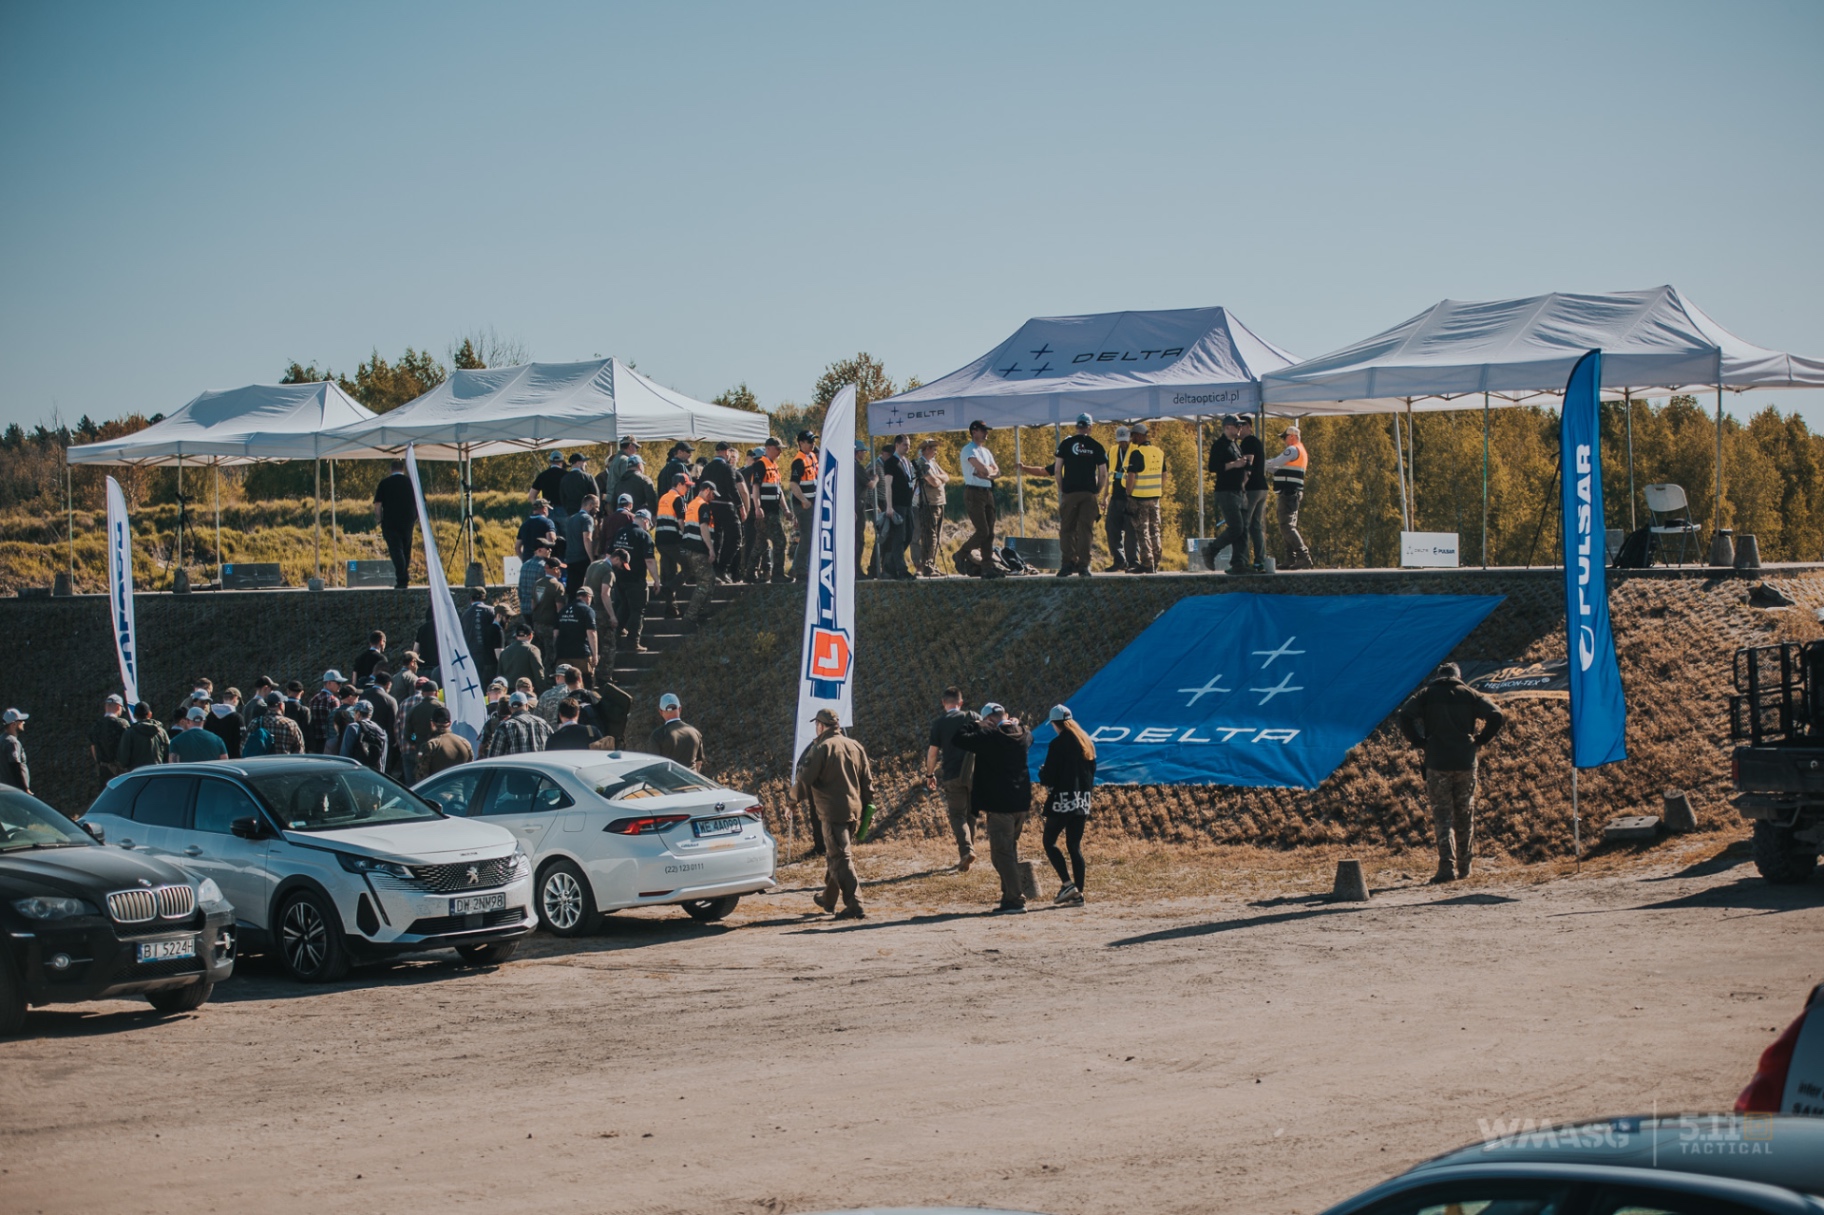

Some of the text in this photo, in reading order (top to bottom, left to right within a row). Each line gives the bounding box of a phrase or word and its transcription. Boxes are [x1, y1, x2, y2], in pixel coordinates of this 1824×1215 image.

[1071, 346, 1185, 364] DELTA
[1172, 389, 1240, 407] deltaoptical.pl
[907, 408, 945, 419] DELTA
[820, 466, 836, 620] LAPUA
[1090, 726, 1301, 745] DELTA
[700, 821, 712, 833] WE
[144, 940, 193, 958] BI 5224H
